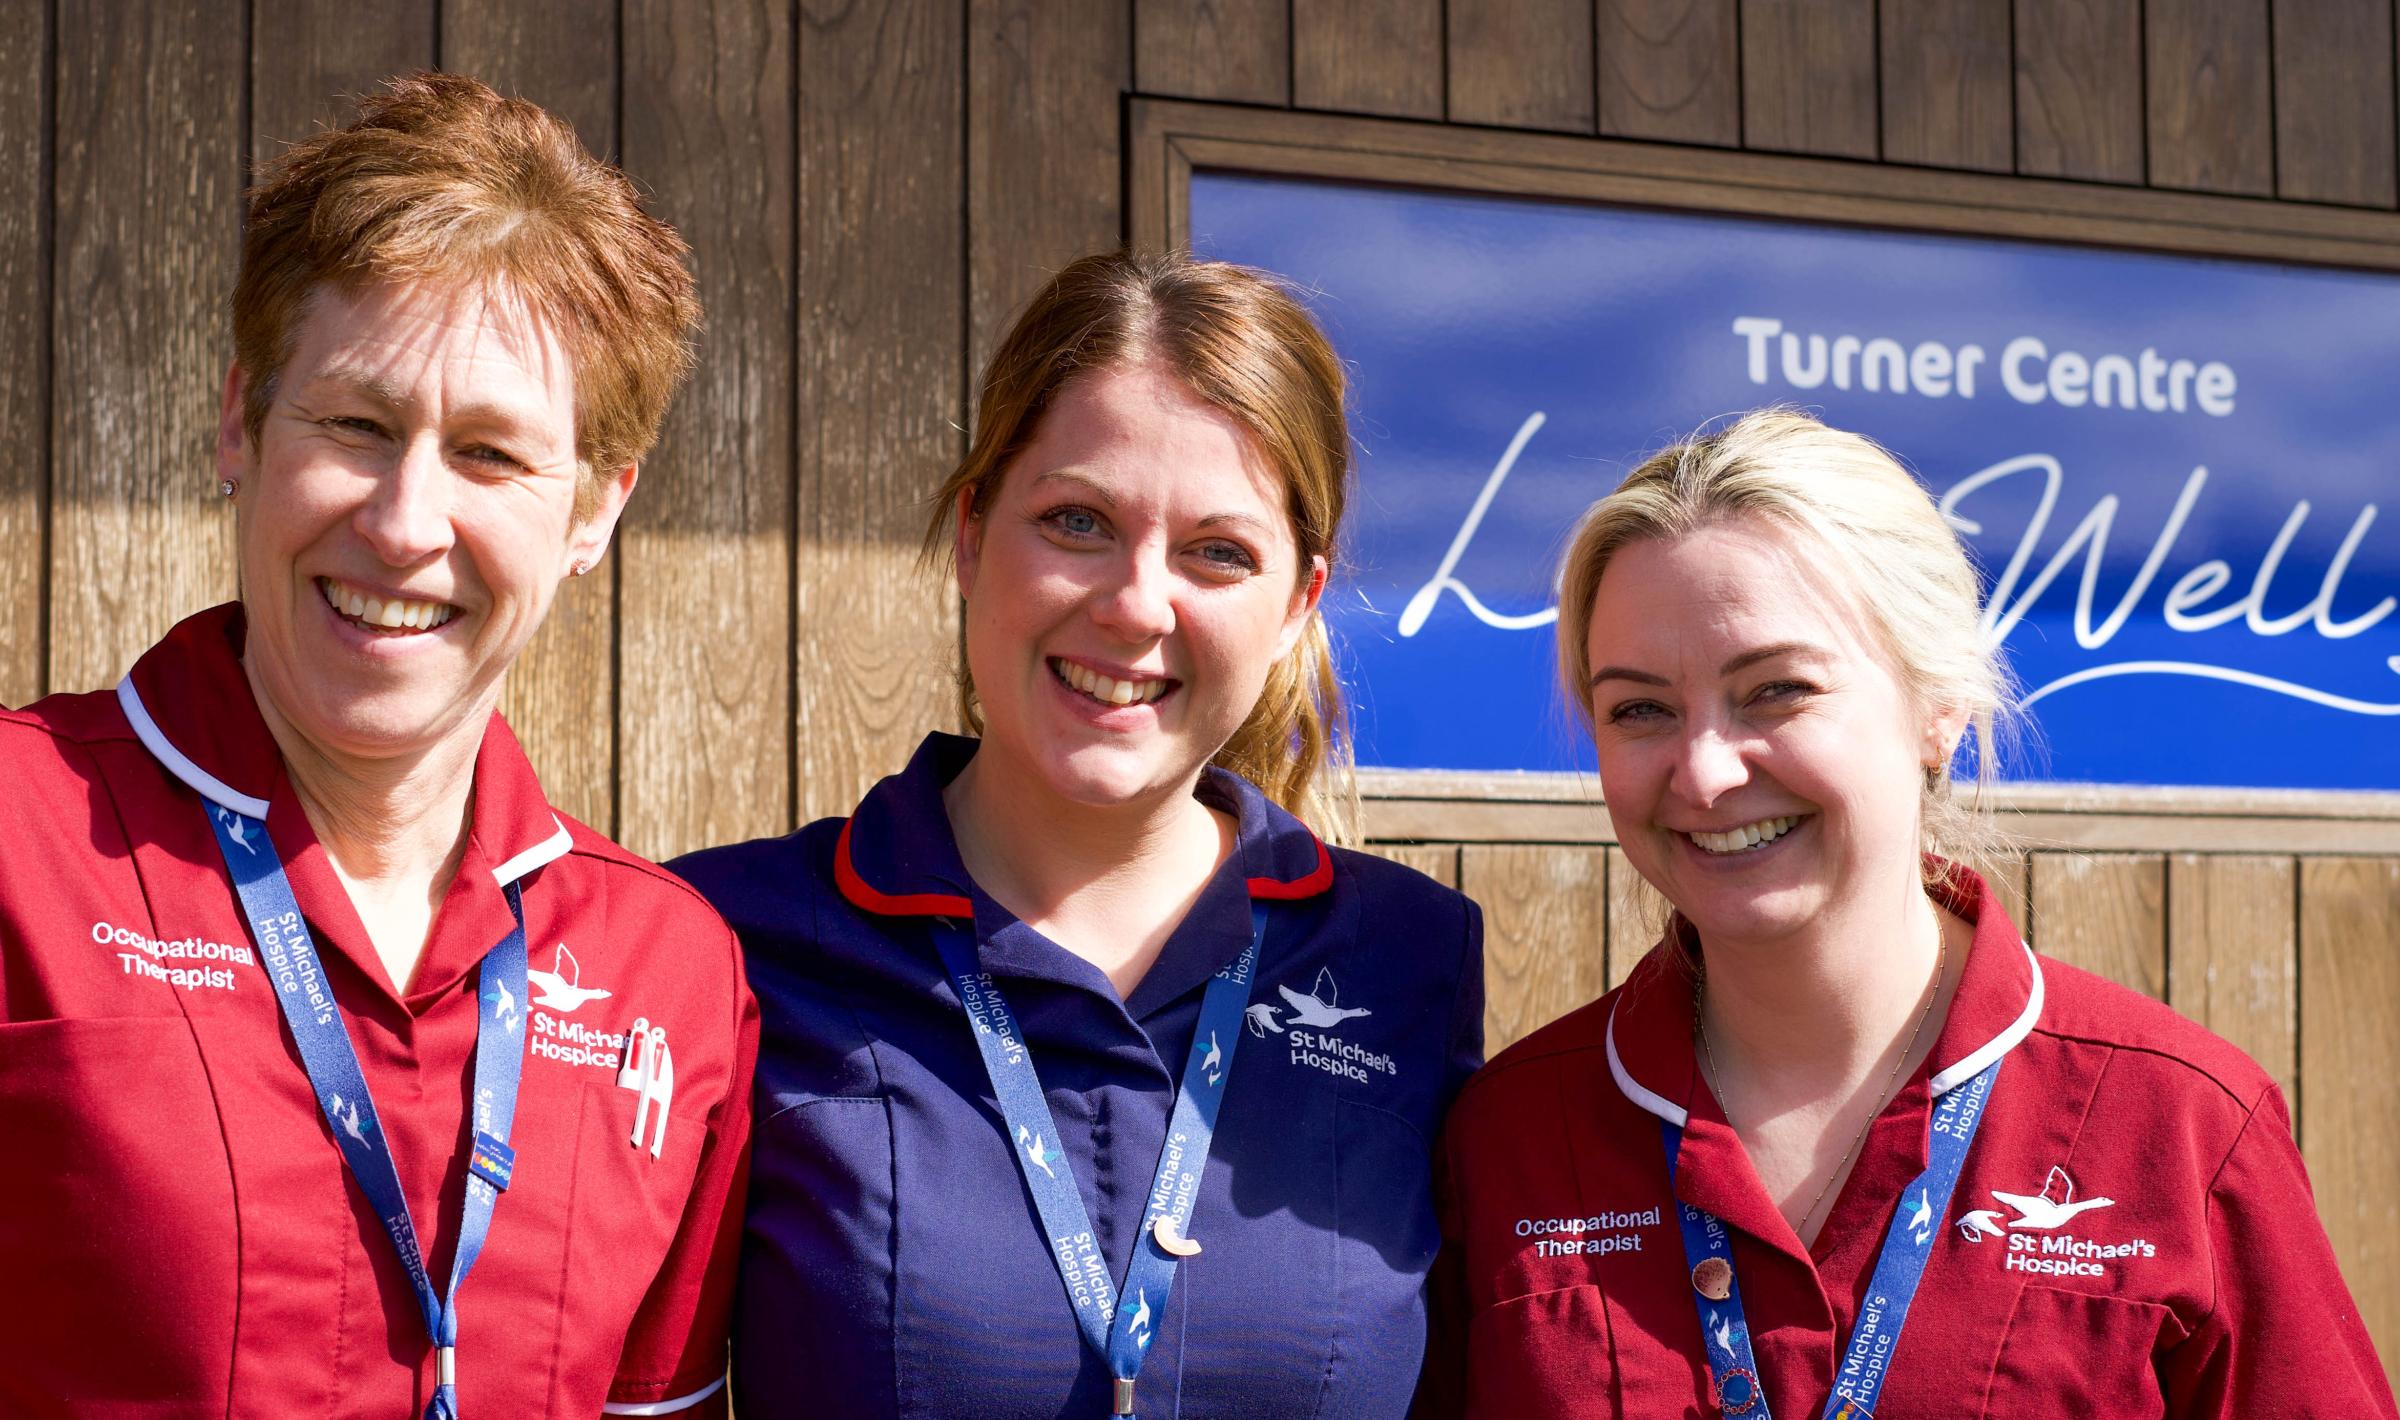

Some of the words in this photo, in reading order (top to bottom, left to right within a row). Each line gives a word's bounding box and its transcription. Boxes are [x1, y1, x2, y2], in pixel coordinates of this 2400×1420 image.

[1732, 315, 1986, 399] Turner
[2000, 335, 2237, 417] Centre
[1938, 453, 2397, 652] Well
[92, 921, 255, 967] Occupational
[278, 911, 299, 935] St
[117, 952, 236, 991] Therapist
[259, 918, 299, 994] Hospice
[288, 935, 332, 1026] Michael's
[534, 1012, 557, 1036] St
[958, 974, 992, 1035] Hospice
[977, 972, 993, 988] St
[986, 989, 1023, 1065] Michael's
[531, 1035, 619, 1068] Hospice
[1289, 1030, 1316, 1048] St
[1319, 1035, 1397, 1075] Michael's
[1291, 1049, 1368, 1084] Hospice
[1934, 1114, 1954, 1133] St
[1952, 1075, 1988, 1140] Hospice
[1152, 1132, 1187, 1211] Michael's
[1172, 1172, 1195, 1230] ospice
[1515, 1206, 1661, 1237] Occupational
[387, 1216, 426, 1292] Hospice
[1074, 1232, 1092, 1253] St
[1534, 1233, 1642, 1258] Therapist
[2006, 1253, 2104, 1276] Hospice
[2008, 1233, 2037, 1252] St
[2041, 1235, 2156, 1259] Michael's
[1056, 1236, 1091, 1307] Hospice
[1844, 1296, 1887, 1376] Michael's
[1837, 1378, 1857, 1399] St
[1854, 1334, 1891, 1403] Hospice
